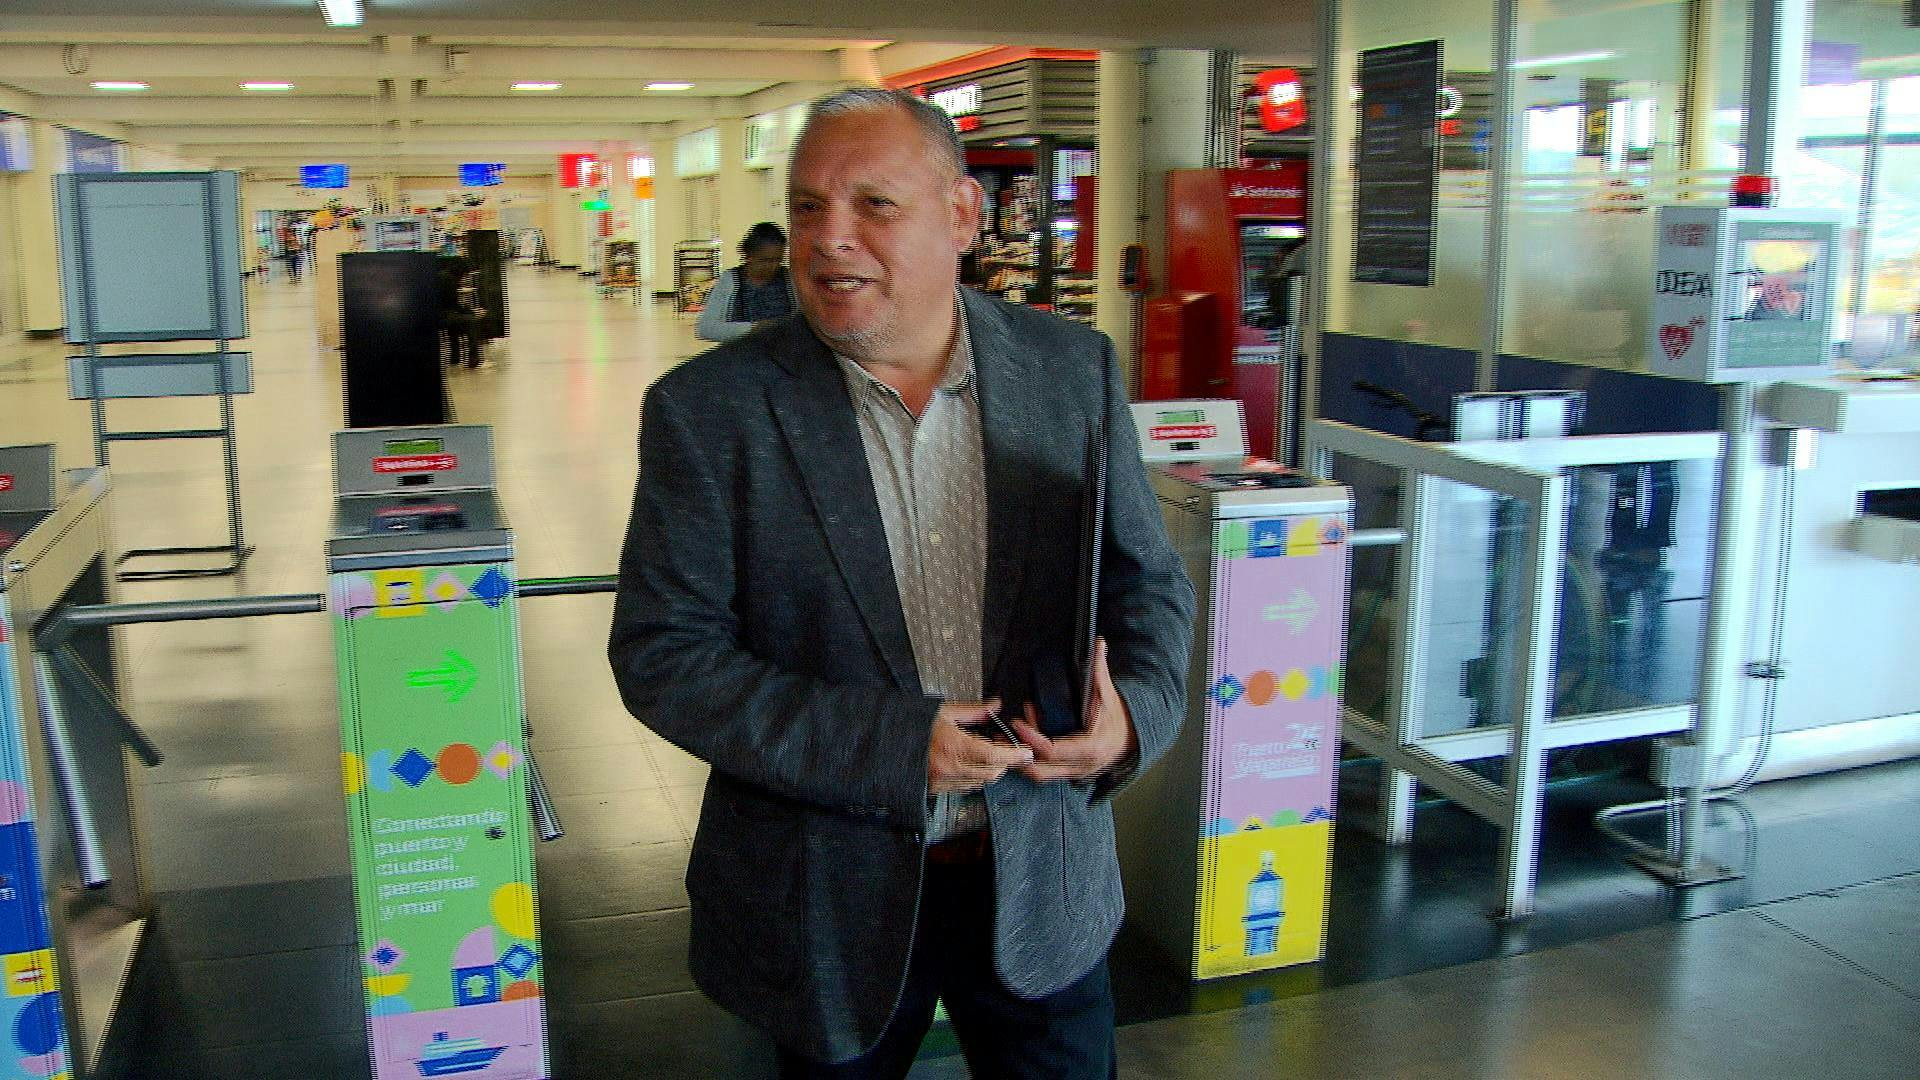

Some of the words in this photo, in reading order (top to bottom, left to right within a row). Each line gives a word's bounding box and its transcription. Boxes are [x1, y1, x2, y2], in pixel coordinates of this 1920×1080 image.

[1657, 269, 1713, 298] DEA
[373, 809, 508, 834] Conectando
[374, 837, 452, 859] puerto
[450, 835, 469, 853] y
[378, 876, 479, 901] personas
[378, 905, 395, 921] y
[398, 900, 445, 914] mar
